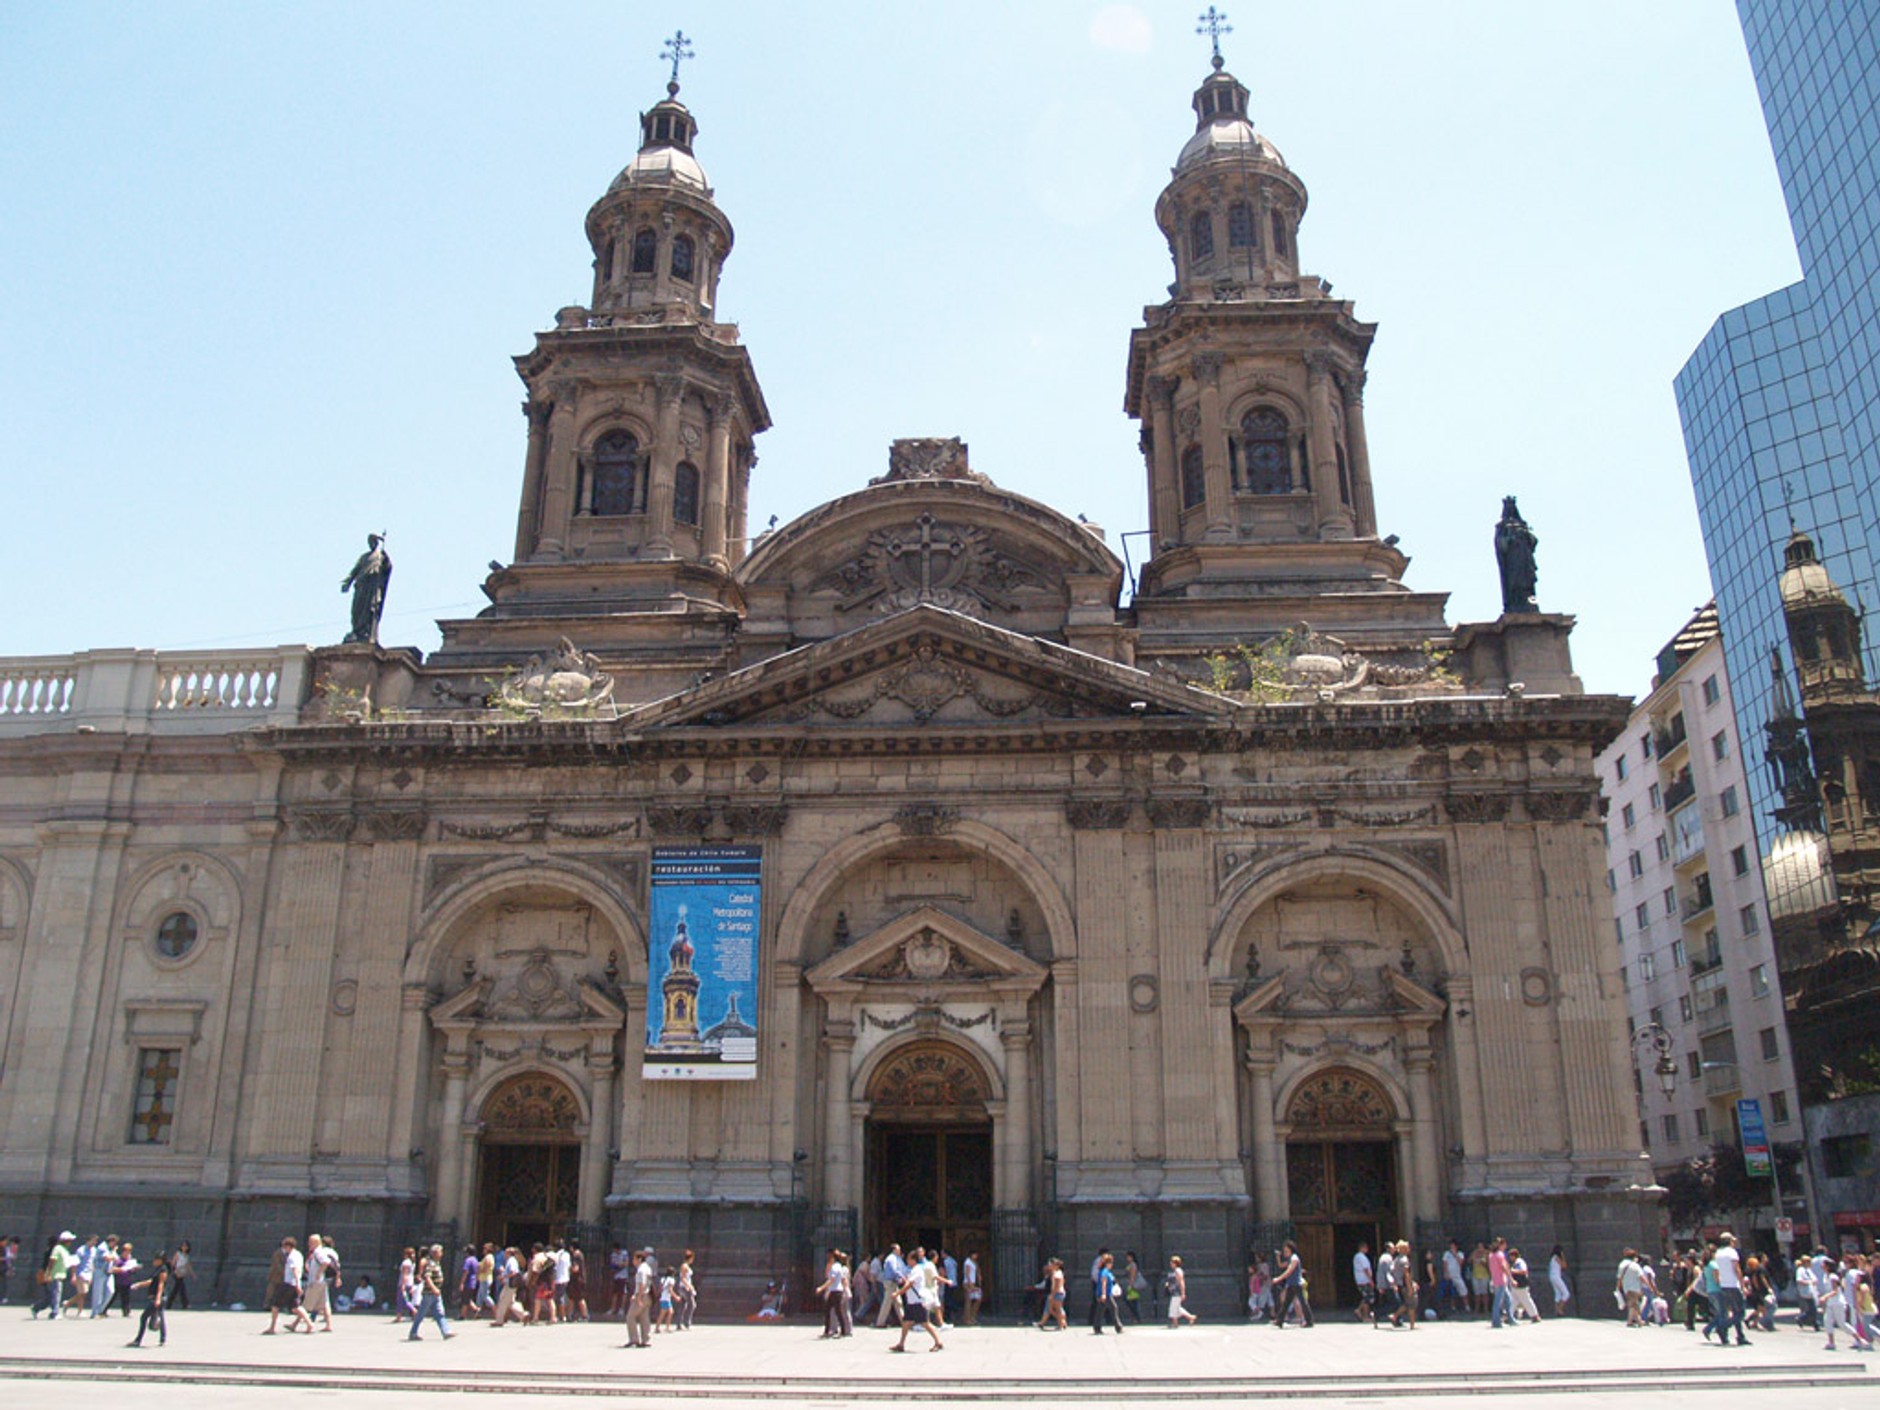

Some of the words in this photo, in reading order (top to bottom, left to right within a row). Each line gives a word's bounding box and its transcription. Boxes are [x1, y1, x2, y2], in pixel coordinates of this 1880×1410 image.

[655, 865, 721, 874] restauración
[729, 893, 754, 903] Catedral
[712, 907, 753, 918] Metropolitana
[717, 921, 726, 931] de
[727, 921, 753, 933] Santiago
